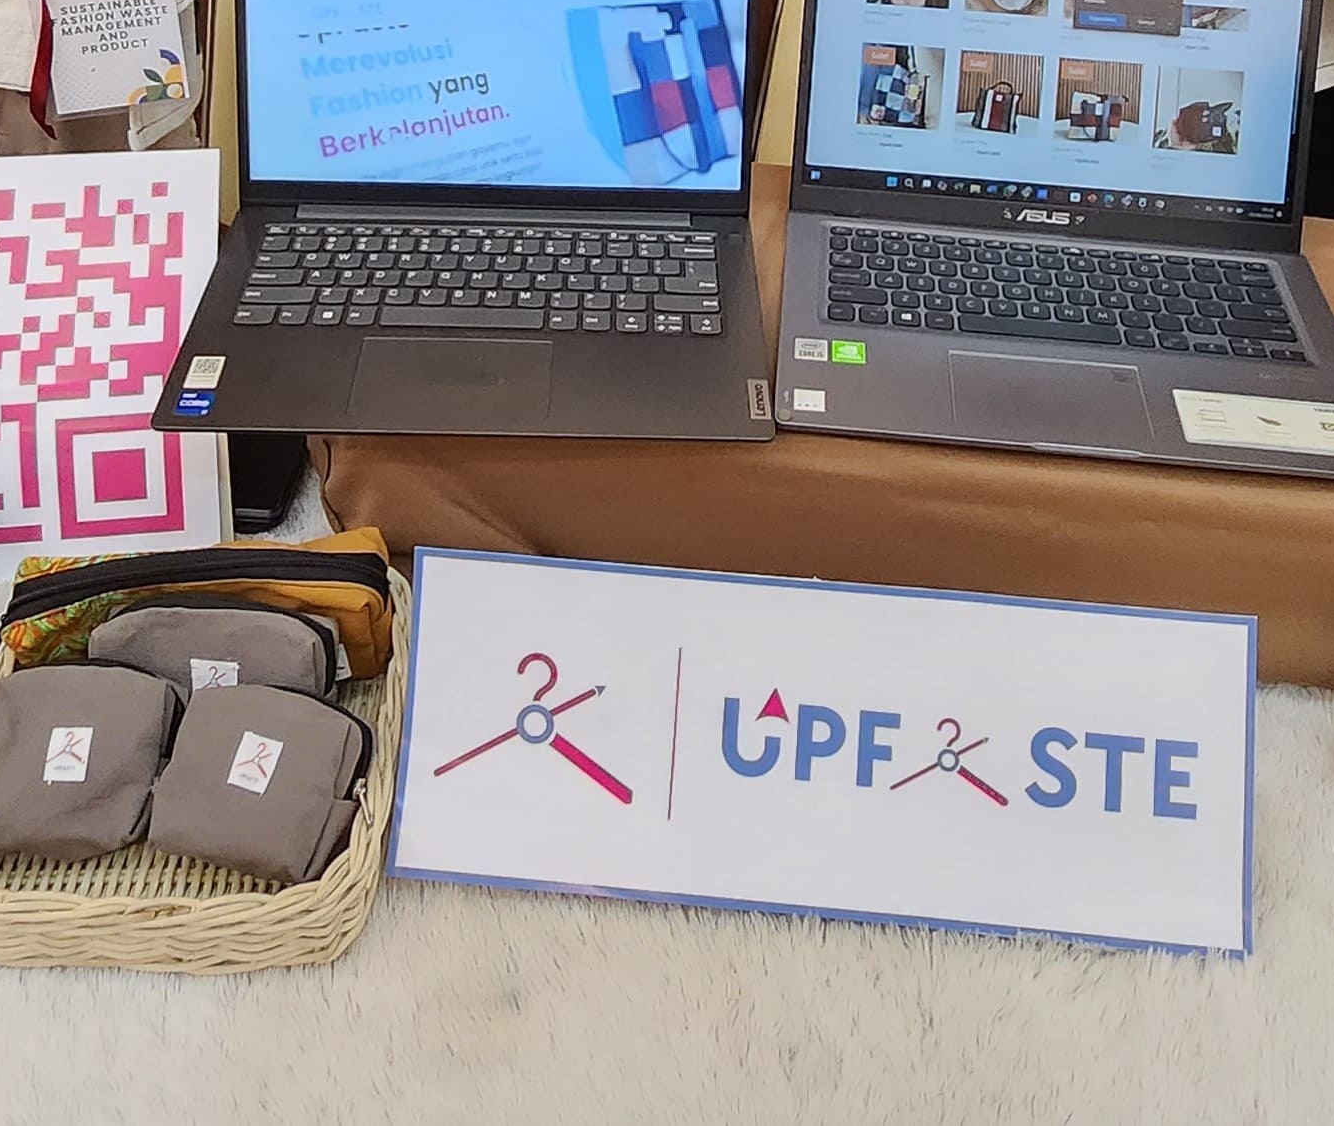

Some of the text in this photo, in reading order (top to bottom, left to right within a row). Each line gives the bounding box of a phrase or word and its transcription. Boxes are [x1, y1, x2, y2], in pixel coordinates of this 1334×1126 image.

[53, 5, 168, 27] FASHION WASTE
[61, 16, 162, 37] MANAGEMENT
[81, 38, 148, 55] PRODUCT
[99, 31, 128, 42] AND
[300, 37, 454, 80] Merevolusi
[308, 72, 490, 118] Fashion yang
[1017, 209, 1070, 225] ASUS
[755, 384, 766, 416] Lenovo
